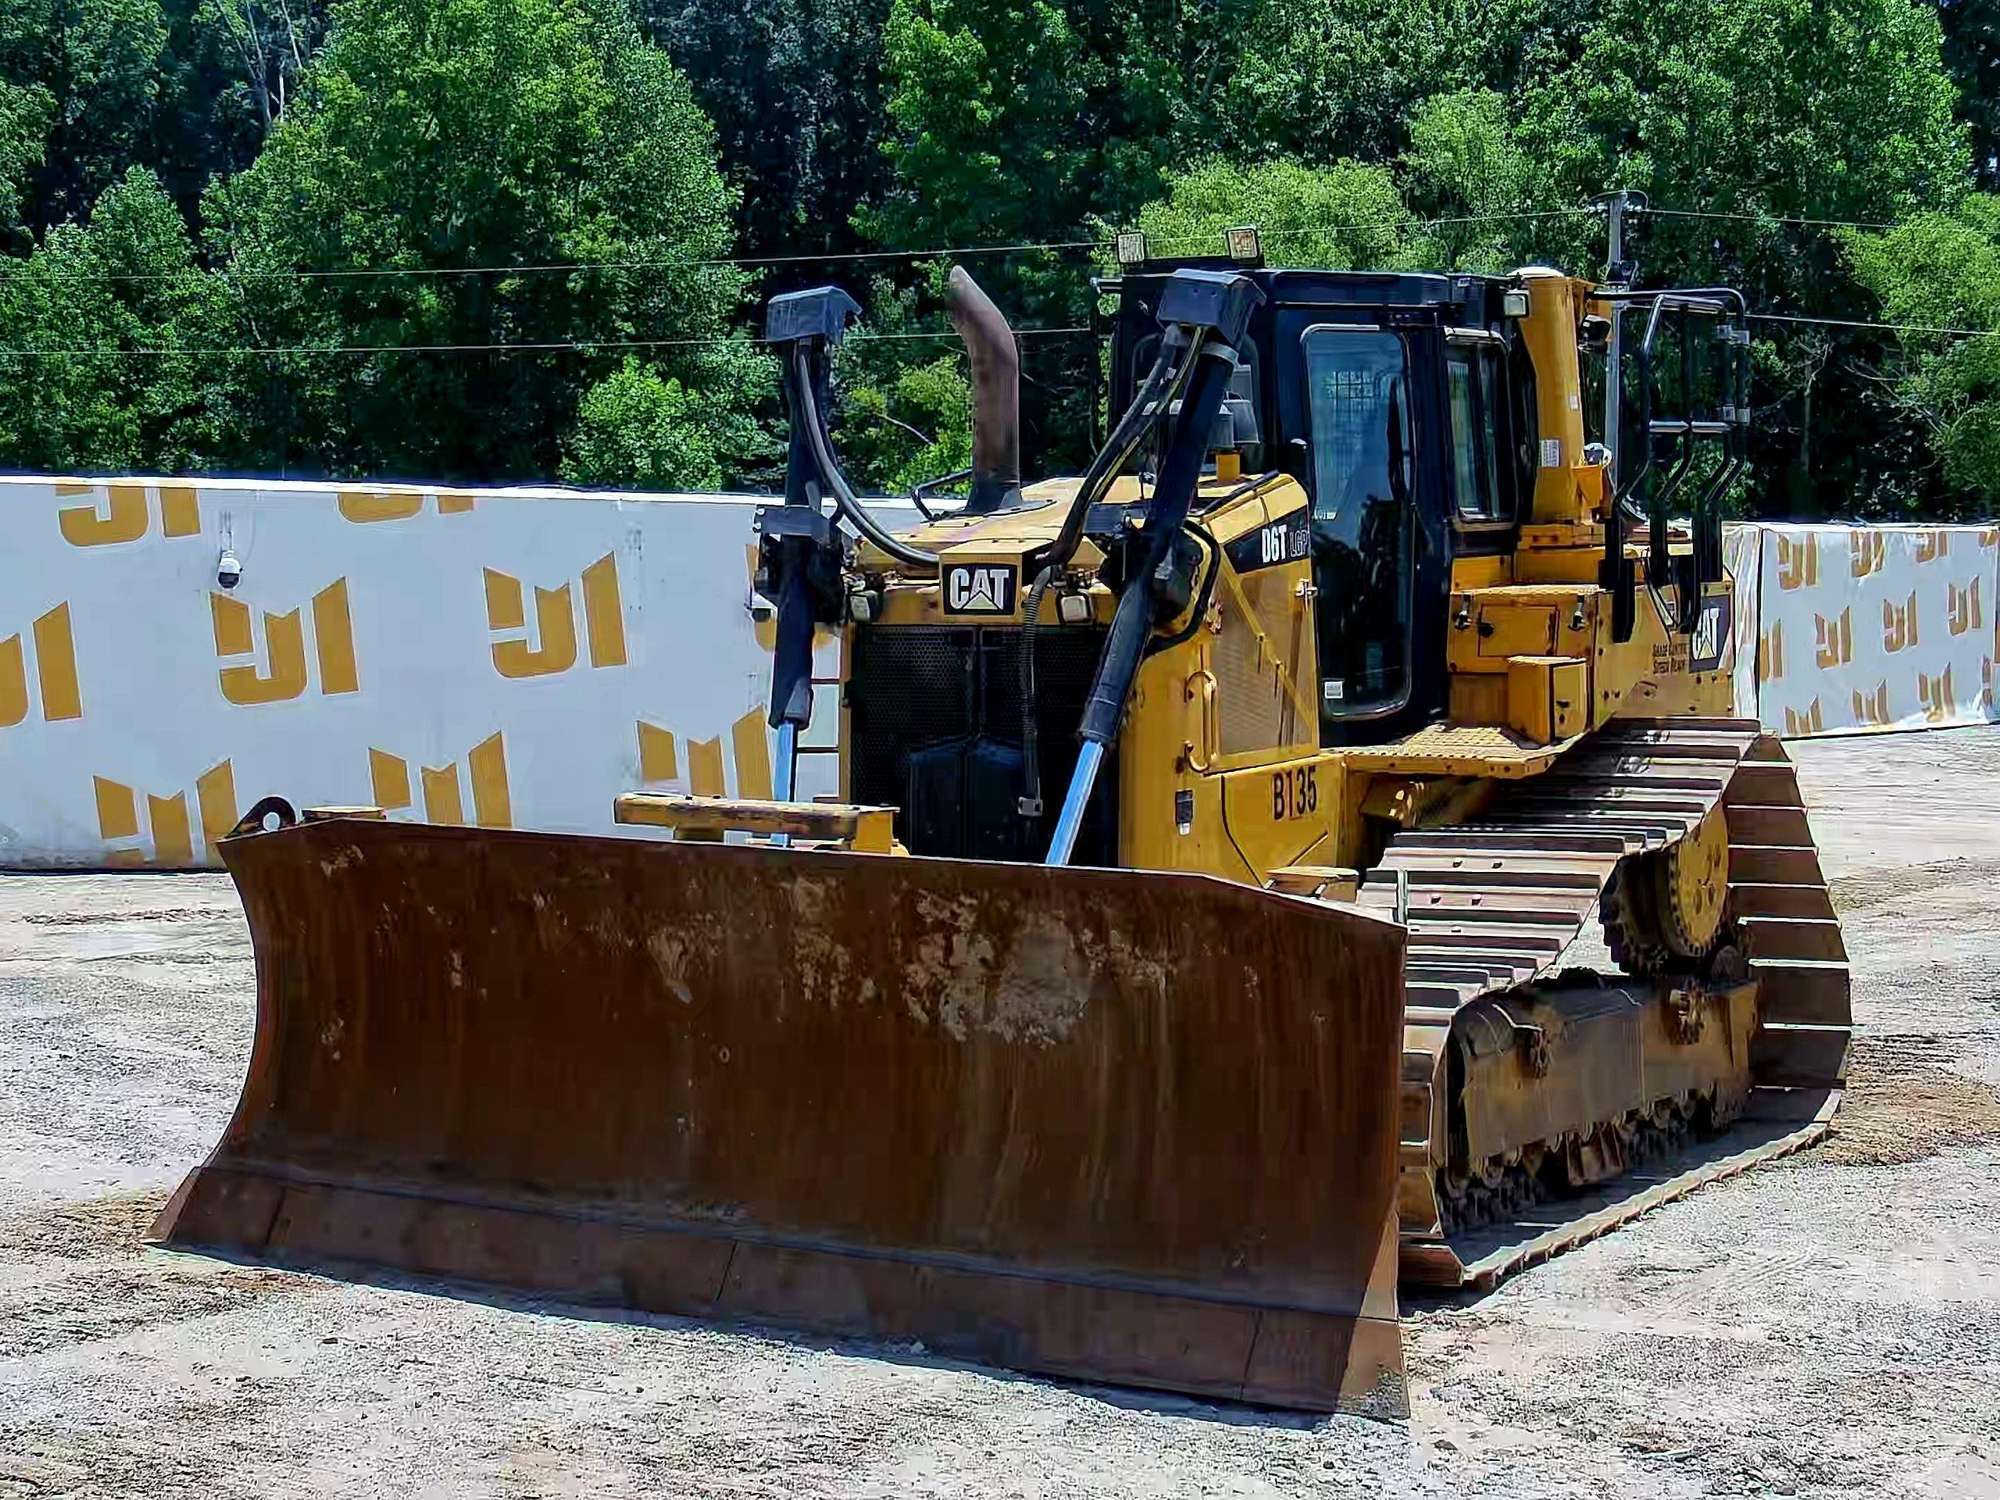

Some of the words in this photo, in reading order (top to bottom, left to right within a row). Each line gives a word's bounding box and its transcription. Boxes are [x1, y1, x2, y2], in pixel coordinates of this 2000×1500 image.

[1261, 524, 1287, 563] D6T
[950, 568, 1009, 610] CAT
[1692, 607, 1720, 660] CAT
[1274, 765, 1317, 820] B135
